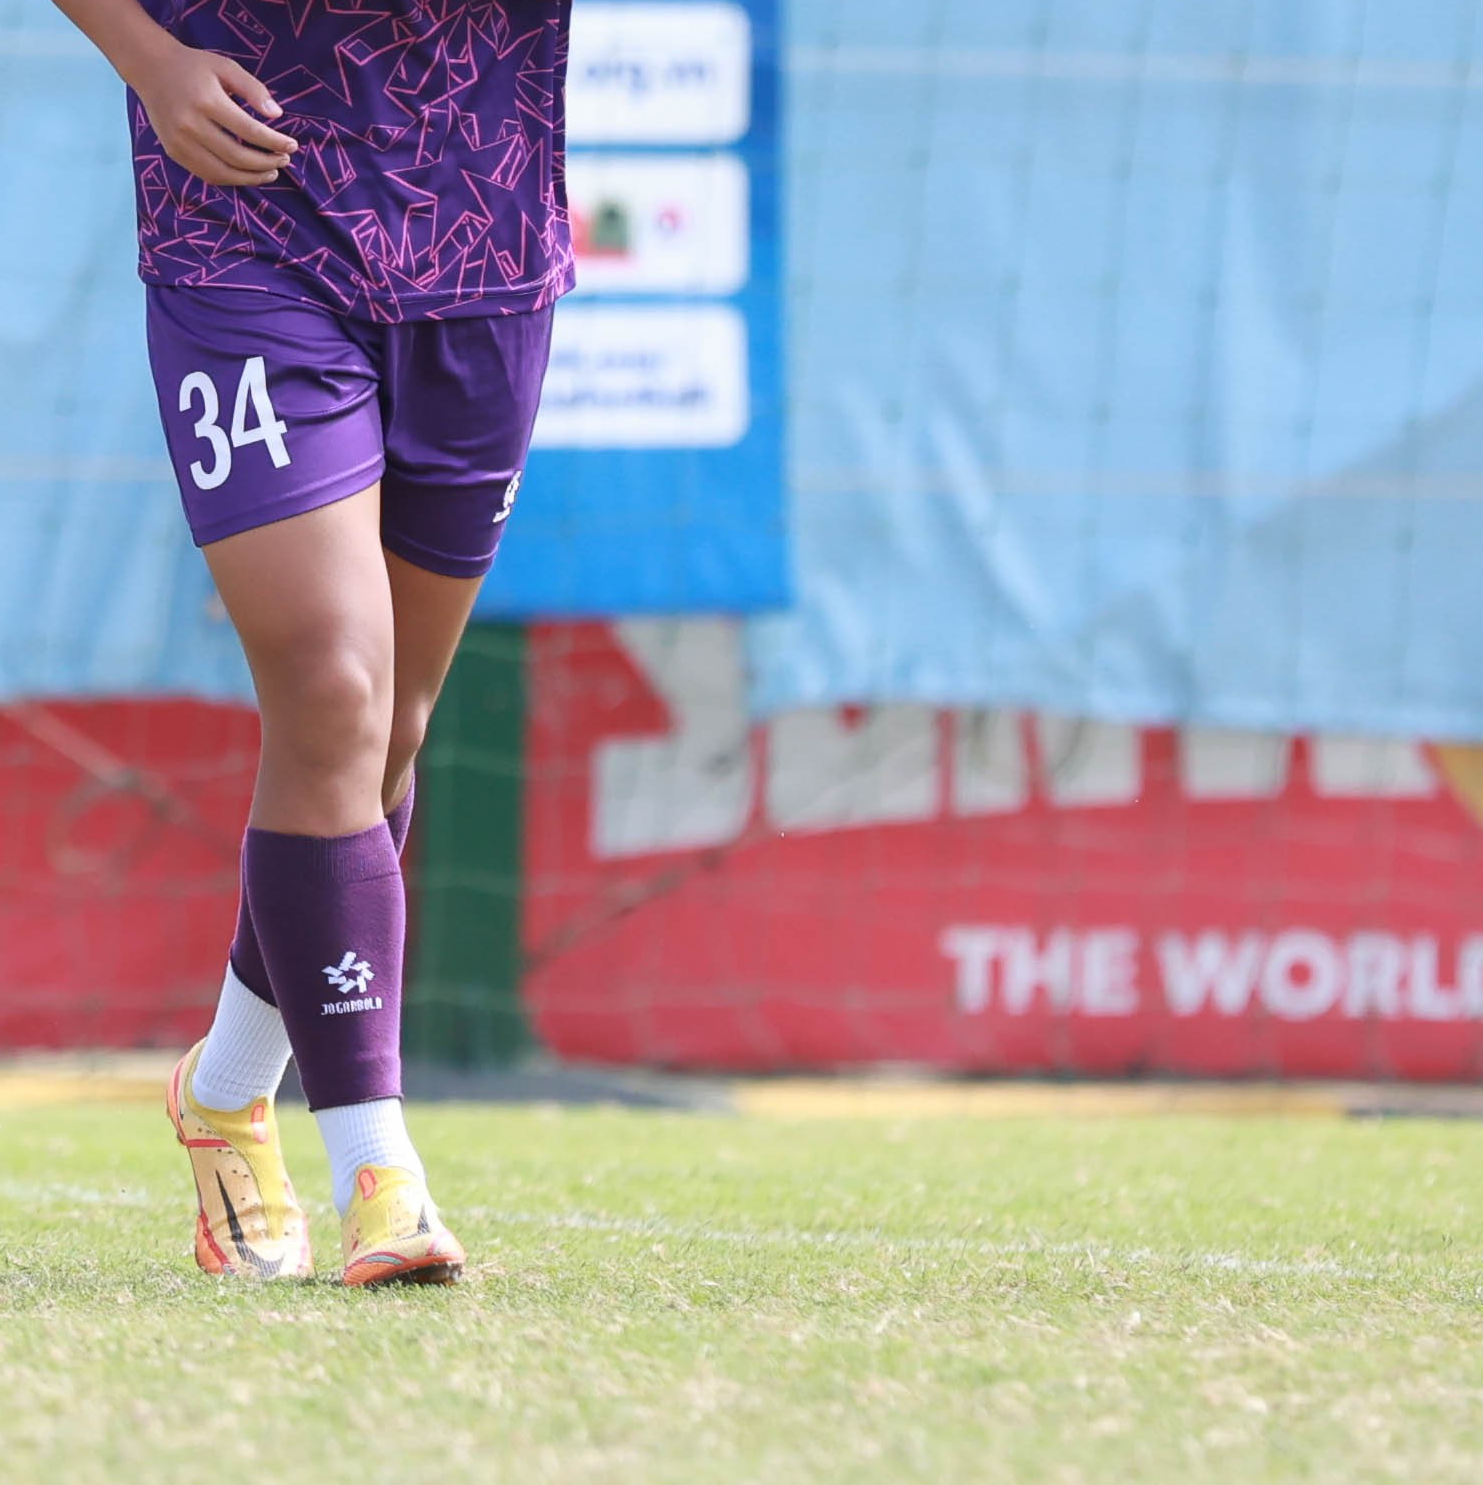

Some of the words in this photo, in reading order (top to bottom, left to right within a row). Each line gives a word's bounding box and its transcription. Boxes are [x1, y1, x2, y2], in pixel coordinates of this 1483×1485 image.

[179, 356, 291, 490] 34
[321, 997, 382, 1016] JOGARBOLA
[940, 925, 1140, 1017] THE
